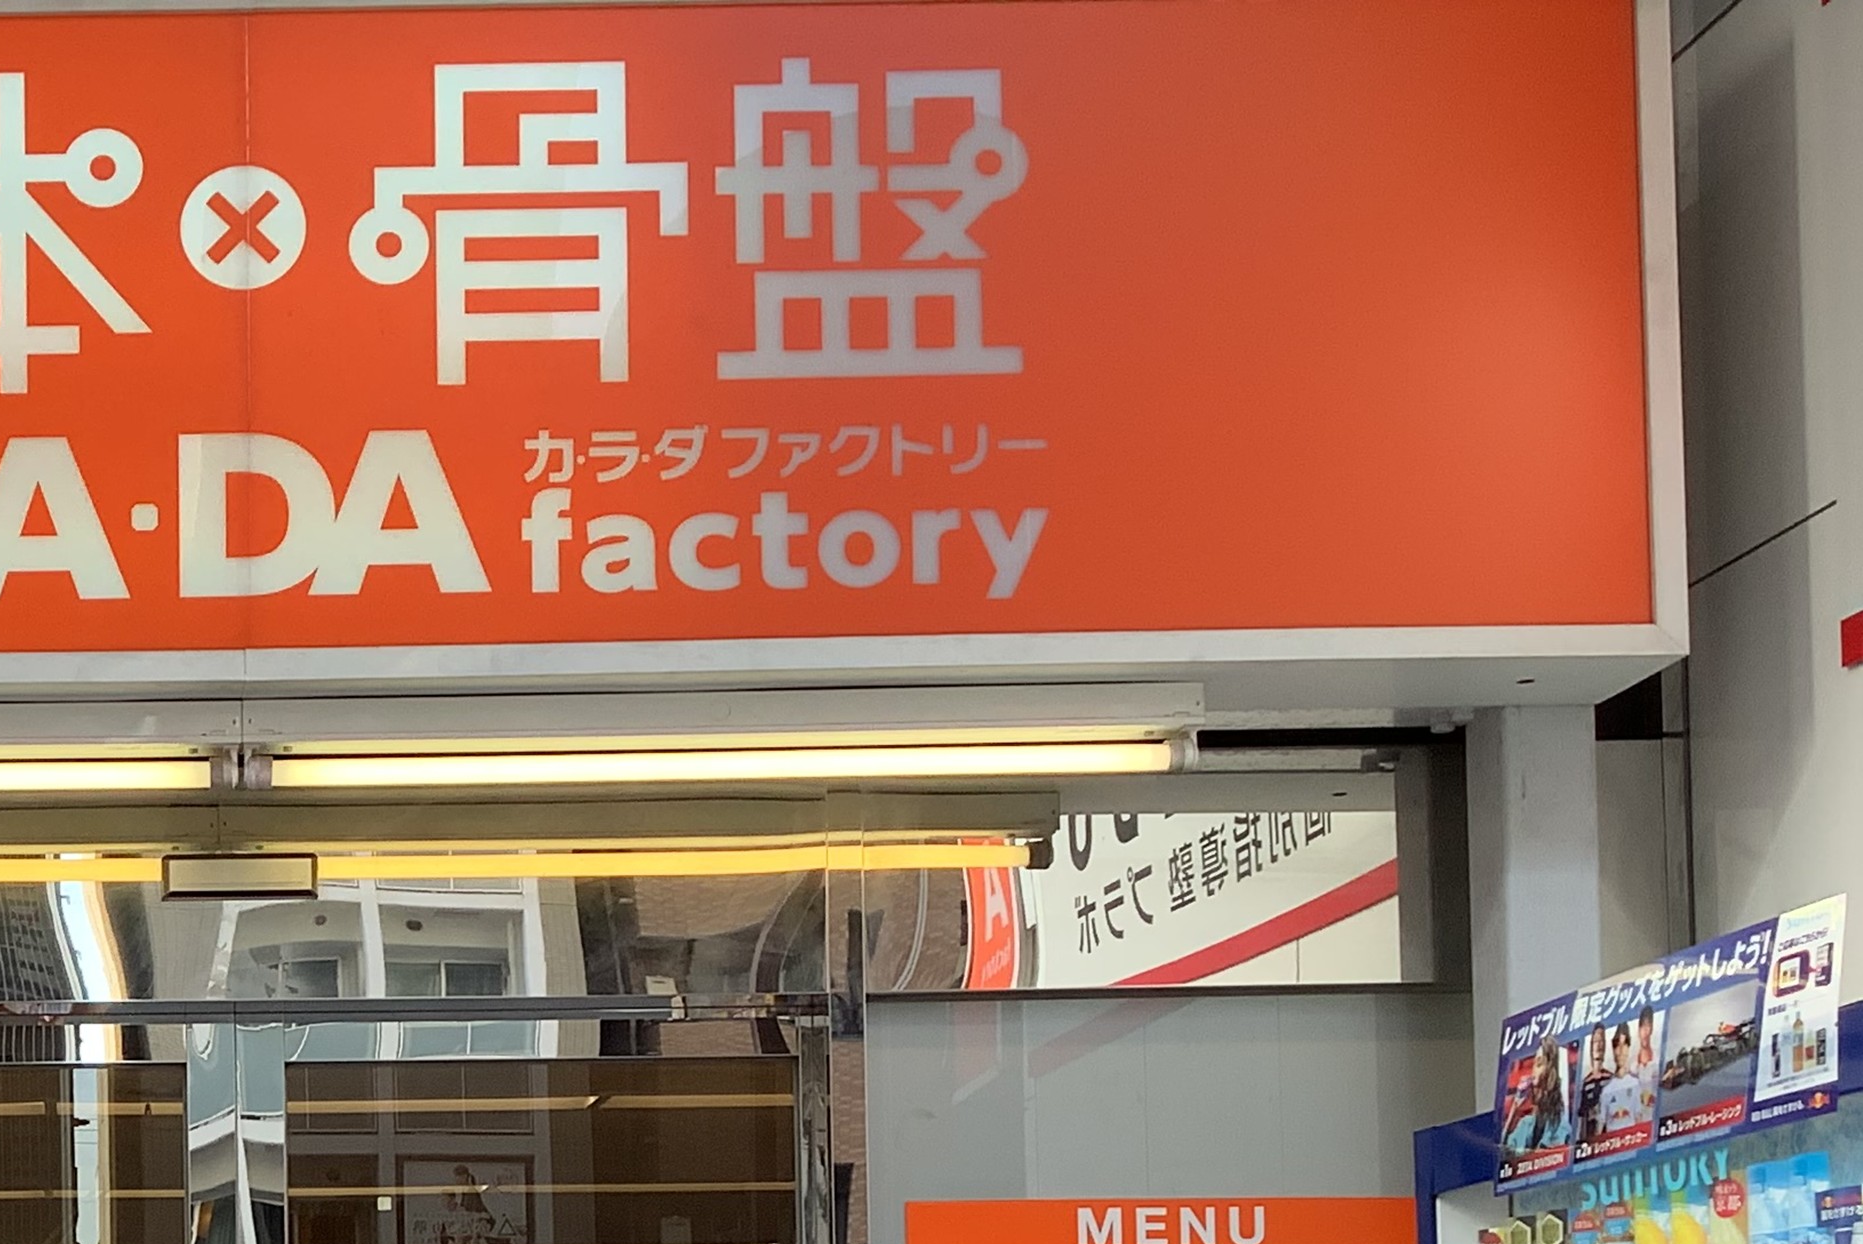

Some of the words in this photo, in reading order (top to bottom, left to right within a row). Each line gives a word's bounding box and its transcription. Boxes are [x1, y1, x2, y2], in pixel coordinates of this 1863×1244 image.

[523, 486, 1049, 602] factory
[1503, 1004, 1569, 1055] レッドブル
